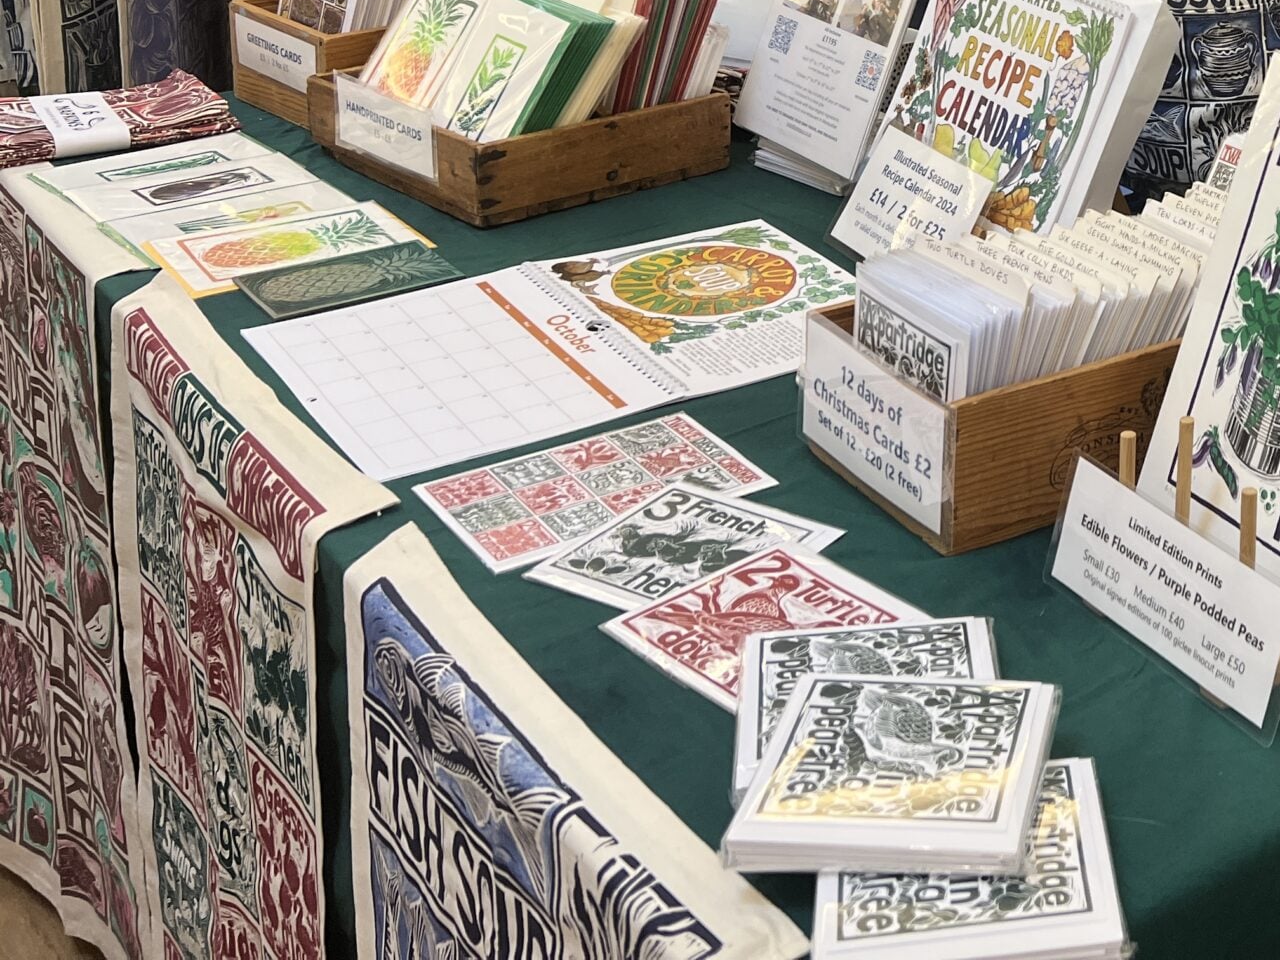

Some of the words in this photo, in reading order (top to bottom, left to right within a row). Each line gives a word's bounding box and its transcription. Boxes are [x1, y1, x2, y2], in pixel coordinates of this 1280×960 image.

[247, 31, 279, 55] GREETINGS
[280, 48, 302, 65] CARDS
[956, 35, 1042, 108] RECIPE
[346, 100, 395, 130] HANDPRINTED
[397, 122, 422, 141] CARDS
[935, 79, 1032, 160] CALENDAR
[893, 149, 930, 177] Illustrated
[927, 169, 963, 196] Seasonal
[1132, 143, 1184, 182] SOUP
[882, 164, 905, 186] Recipe
[904, 178, 936, 207] Calendar
[935, 196, 958, 217] 2024
[869, 188, 888, 208] £14
[923, 220, 946, 241] £25
[1087, 227, 1110, 242] SEVEN
[702, 246, 794, 286] CARROT
[925, 238, 942, 252] TWO
[944, 246, 975, 268] TURTLE
[979, 261, 1009, 284] DOVES
[976, 241, 999, 260] THREE
[1002, 256, 1029, 273] FRENCH
[1033, 270, 1054, 285] HENS
[1007, 240, 1025, 258] FOUR
[1050, 263, 1075, 283] BIRDS
[1055, 248, 1075, 267] GOLD
[1070, 239, 1094, 255] GEESE
[1171, 241, 1204, 263] DANCING
[683, 265, 742, 292] SOUP
[546, 314, 596, 354] October
[878, 320, 945, 376] partridge
[840, 365, 855, 390] 12
[856, 378, 885, 414] days
[888, 404, 903, 426] of
[813, 378, 870, 436] Christmas
[873, 424, 910, 466] Cards
[914, 453, 932, 480] £2
[817, 410, 832, 431] Set
[834, 421, 844, 441] of
[845, 432, 856, 453] 12
[864, 449, 883, 472] £20
[885, 462, 895, 482] (2
[897, 471, 923, 502] free)
[645, 491, 692, 521] 3
[682, 498, 770, 538] French
[1128, 516, 1161, 546] Limited
[1162, 532, 1193, 568] Edition
[1195, 558, 1224, 589] Prints
[734, 555, 783, 587] 2
[793, 577, 871, 627] Turtle
[1081, 513, 1110, 544] Edible
[1111, 530, 1150, 572] Flowers
[1158, 567, 1192, 603] Purple
[1193, 590, 1236, 631] Podded
[1237, 622, 1266, 652] Peas
[1082, 548, 1104, 572] Small
[1105, 563, 1121, 584] £30
[1133, 585, 1168, 618] Medium
[1168, 609, 1186, 631] £40
[1201, 633, 1226, 665] Large
[1227, 651, 1246, 676] £50
[1083, 569, 1107, 593] Original
[1106, 582, 1128, 608] signed
[1127, 597, 1152, 626] editions
[1161, 624, 1173, 640] 100
[1173, 634, 1193, 657] giclee
[1193, 644, 1216, 672] linocut
[1215, 663, 1236, 689] prints
